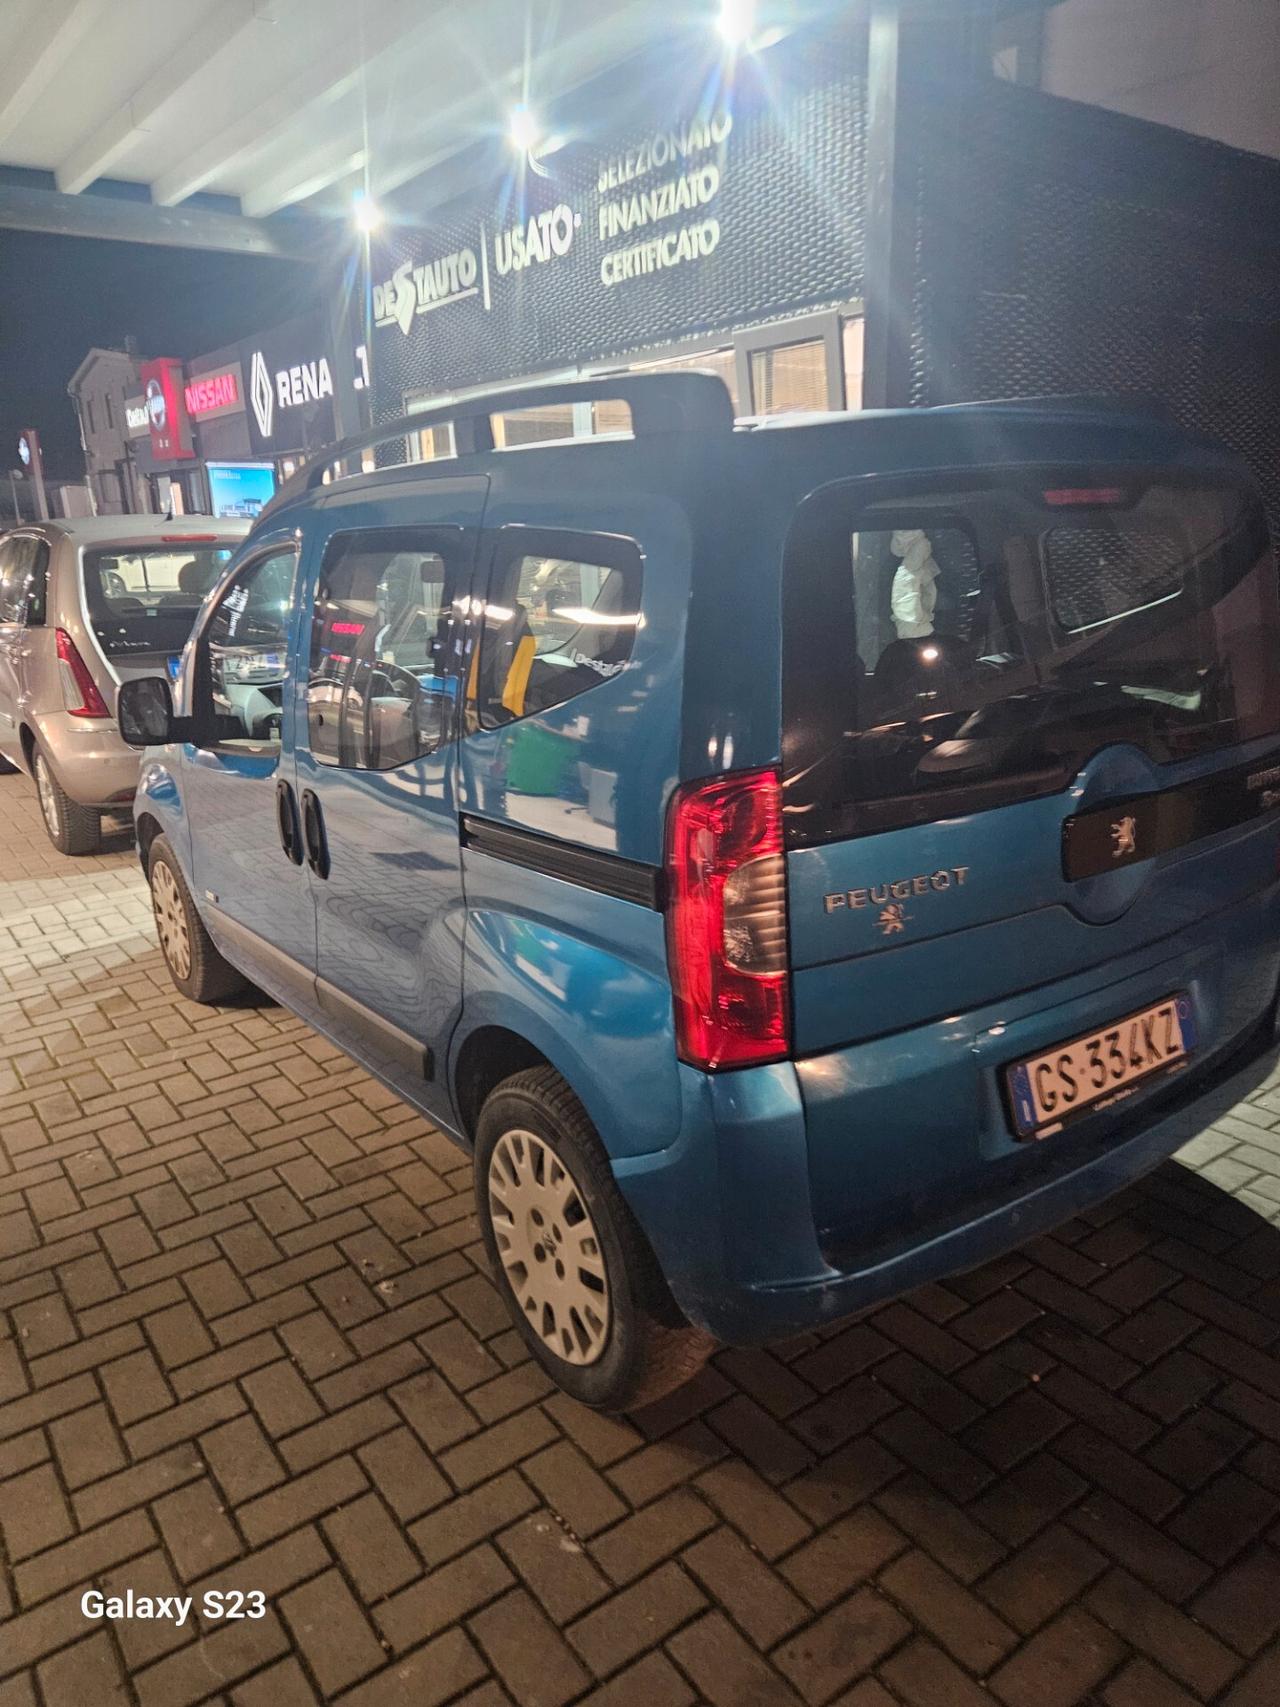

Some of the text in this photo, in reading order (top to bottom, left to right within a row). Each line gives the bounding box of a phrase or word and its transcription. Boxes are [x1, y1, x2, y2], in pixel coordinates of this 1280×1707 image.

[598, 163, 720, 241] FINANZIATO
[372, 203, 574, 336] DESTAUTO USATO
[600, 218, 720, 287] CERTIFICATO
[184, 374, 238, 416] NISSAN
[823, 865, 970, 914] PEUGEOT
